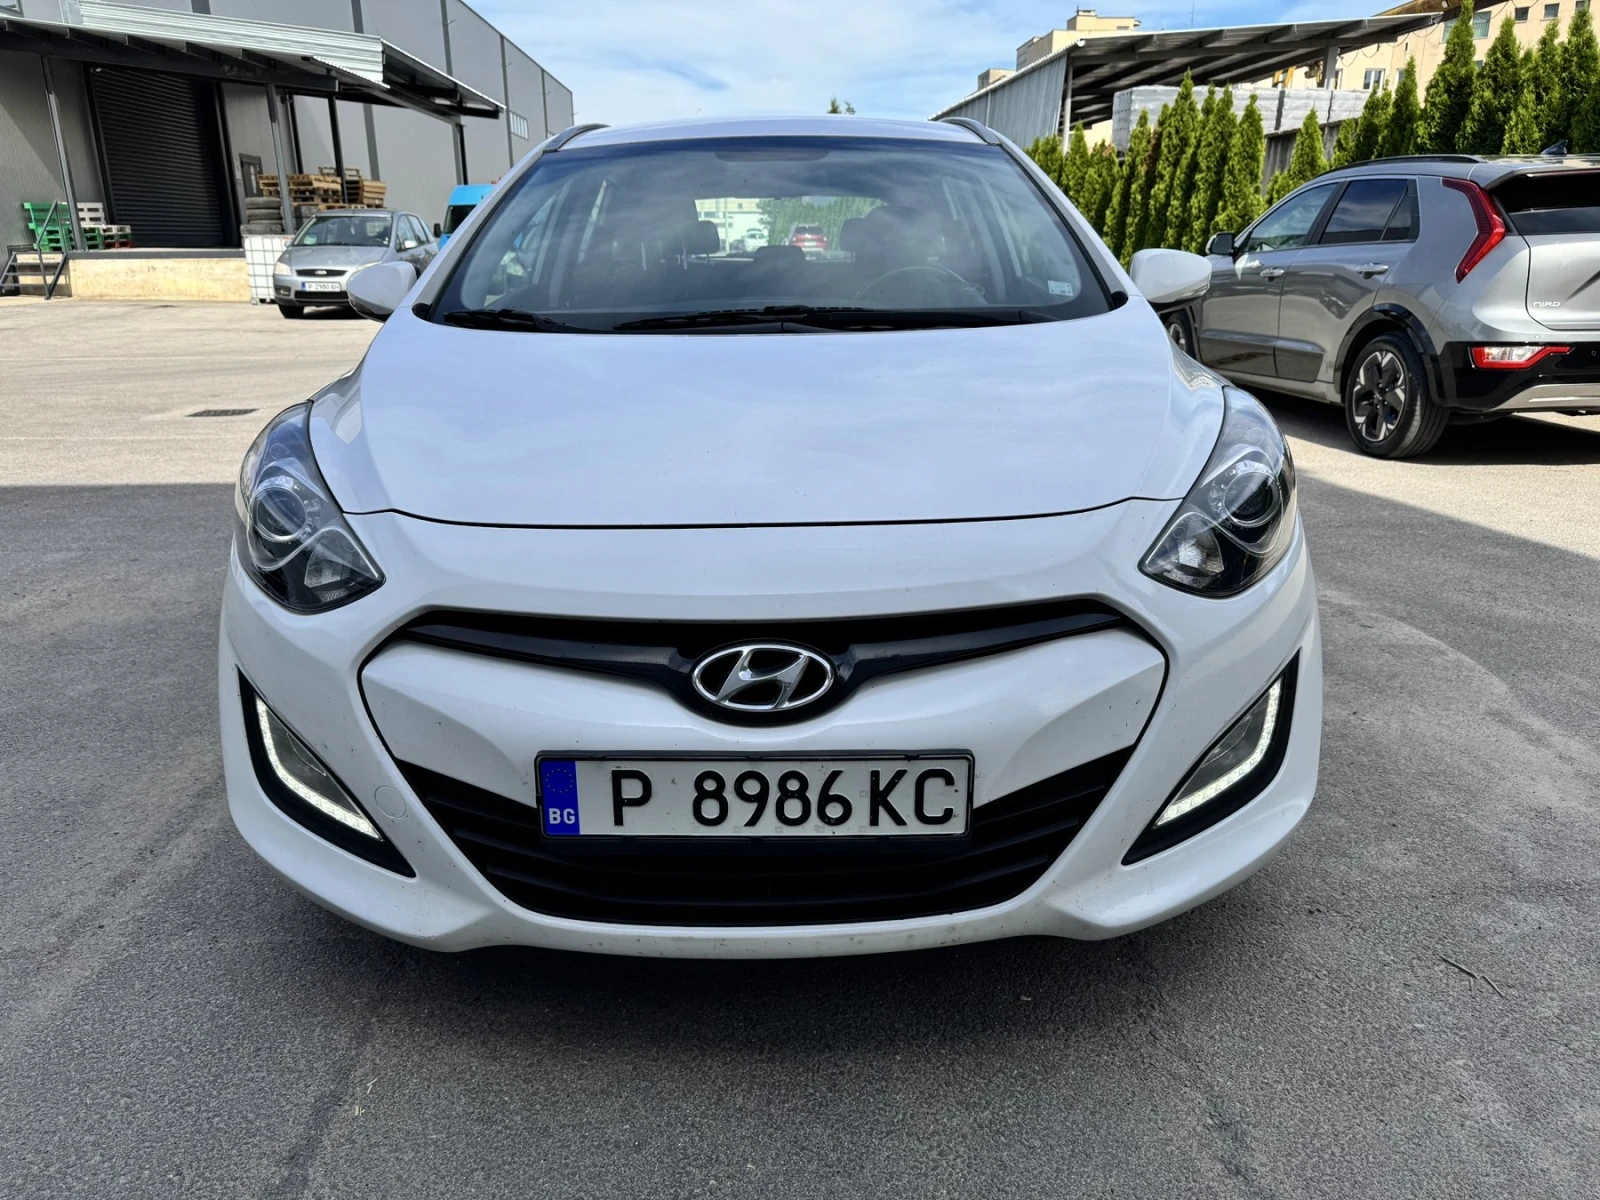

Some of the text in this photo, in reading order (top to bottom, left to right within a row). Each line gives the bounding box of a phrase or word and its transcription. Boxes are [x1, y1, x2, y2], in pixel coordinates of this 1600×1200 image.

[548, 807, 576, 825] BG
[611, 768, 955, 827] P 8986 KC
